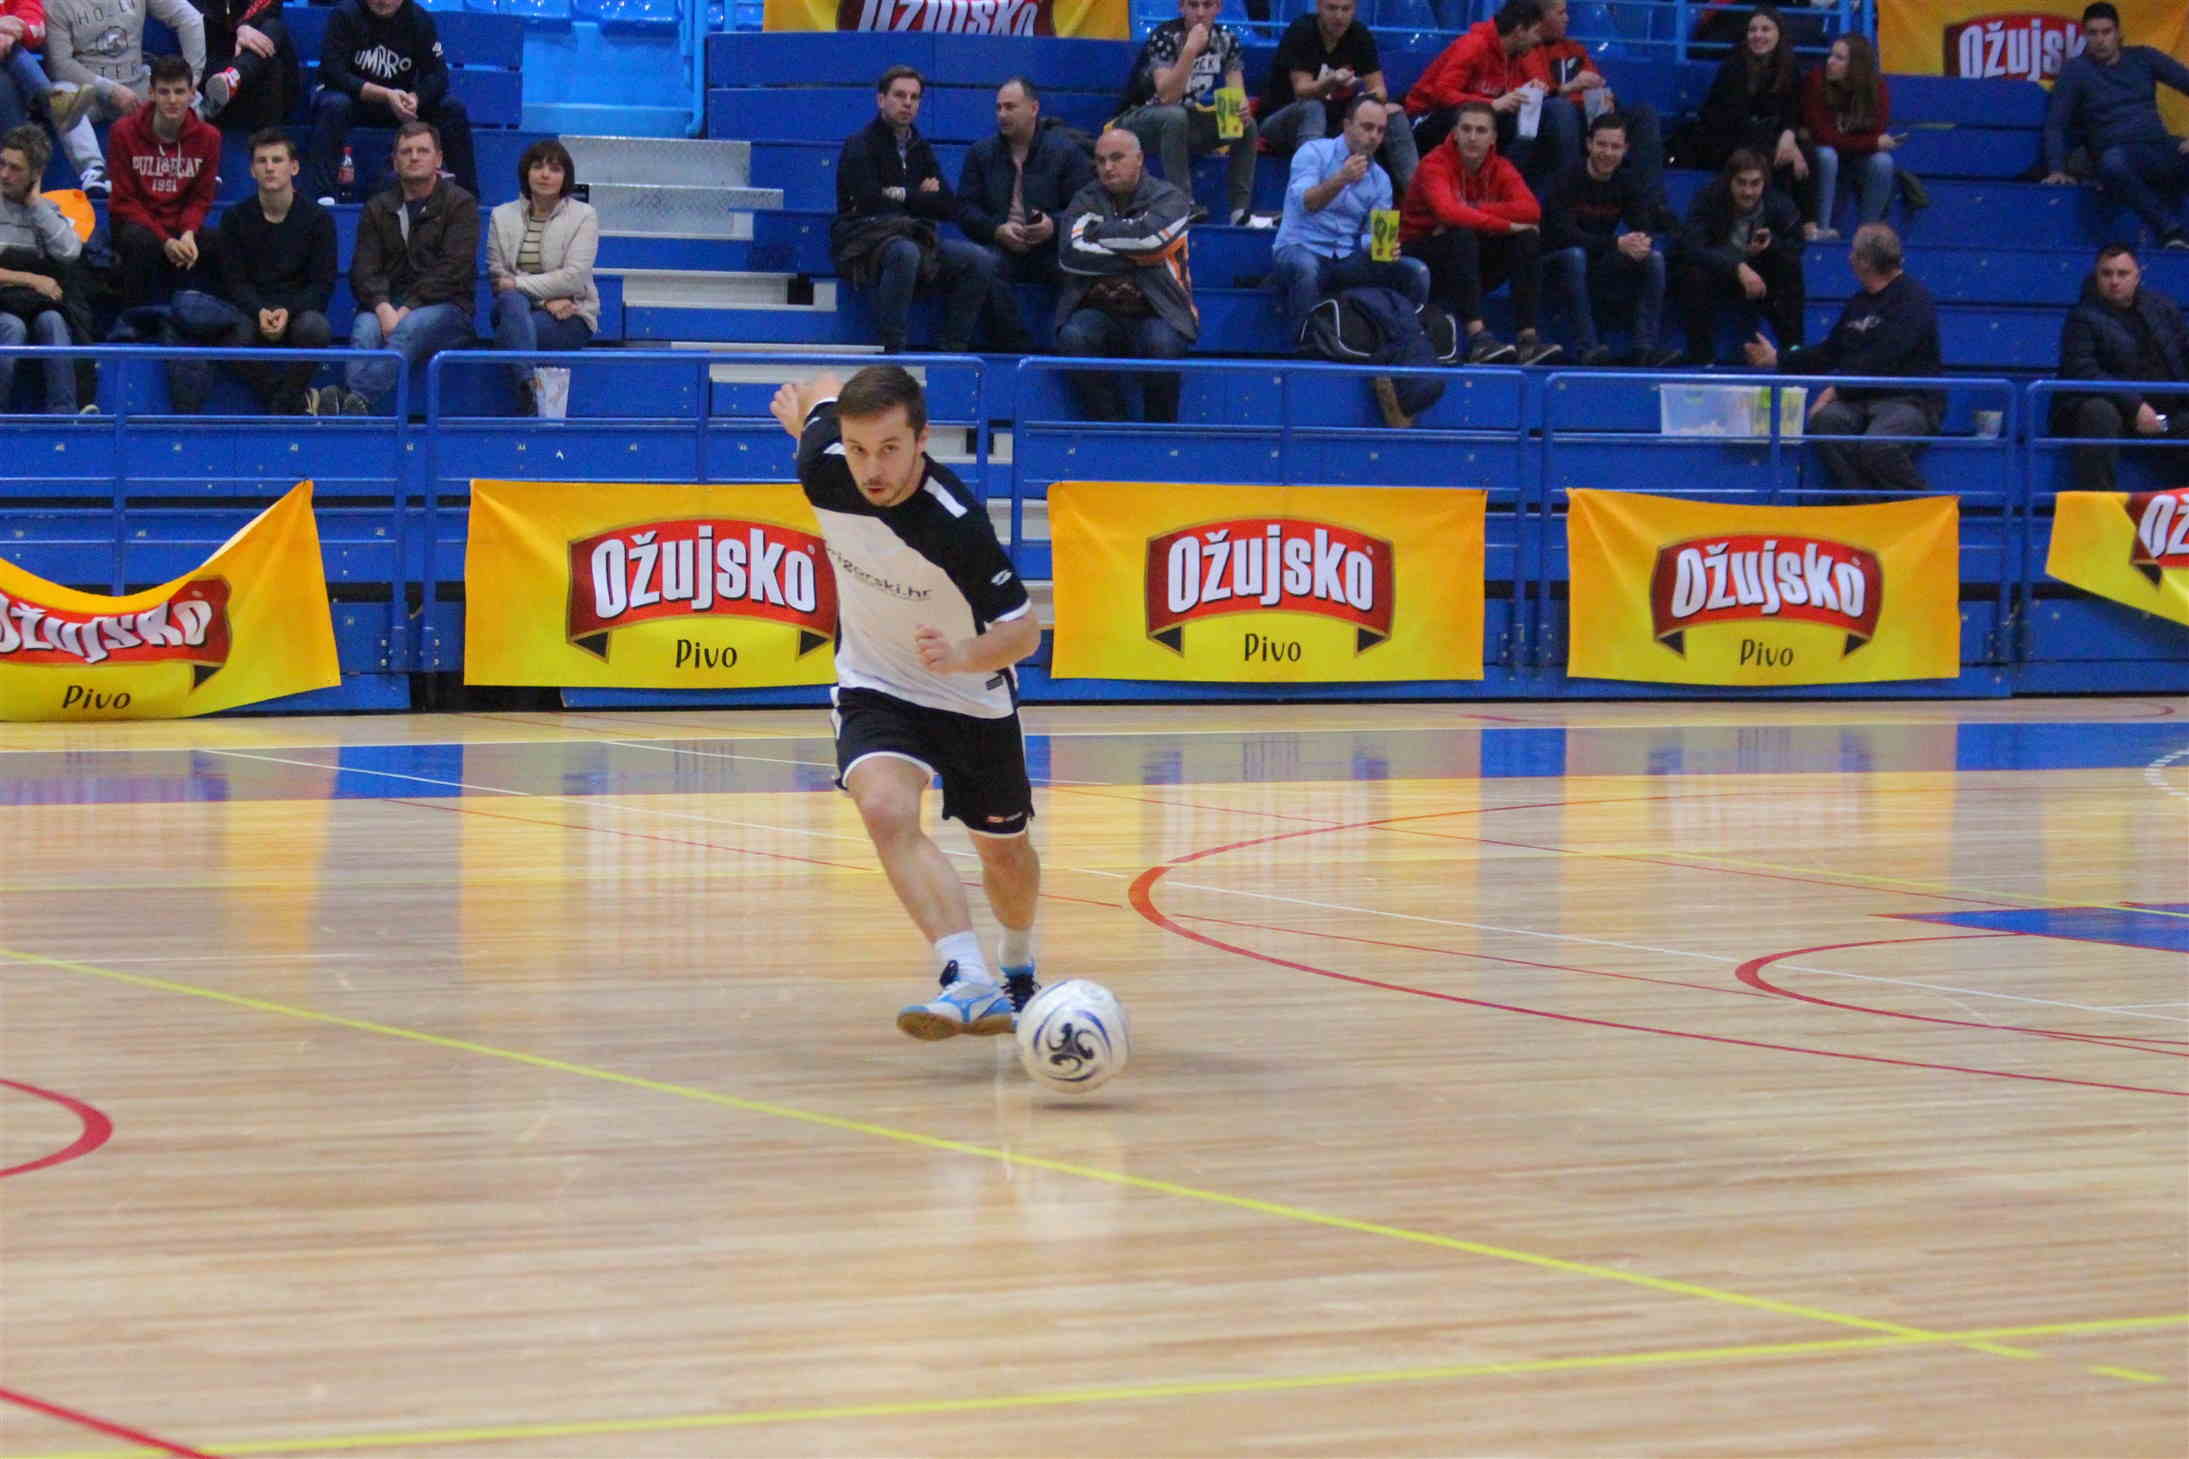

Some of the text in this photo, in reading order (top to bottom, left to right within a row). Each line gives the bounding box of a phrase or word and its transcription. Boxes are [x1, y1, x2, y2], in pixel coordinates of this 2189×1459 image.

[355, 45, 412, 79] UMBRO
[1959, 18, 2088, 81] Ožujsk
[591, 525, 816, 619] Ožujsko
[1168, 524, 1373, 613] Ožujsko
[1671, 540, 1866, 618] Ožujsko
[675, 639, 738, 669] Pivo
[1244, 633, 1302, 662] Pivo
[1739, 639, 1794, 667] Pivo
[62, 685, 131, 709] Pivo
